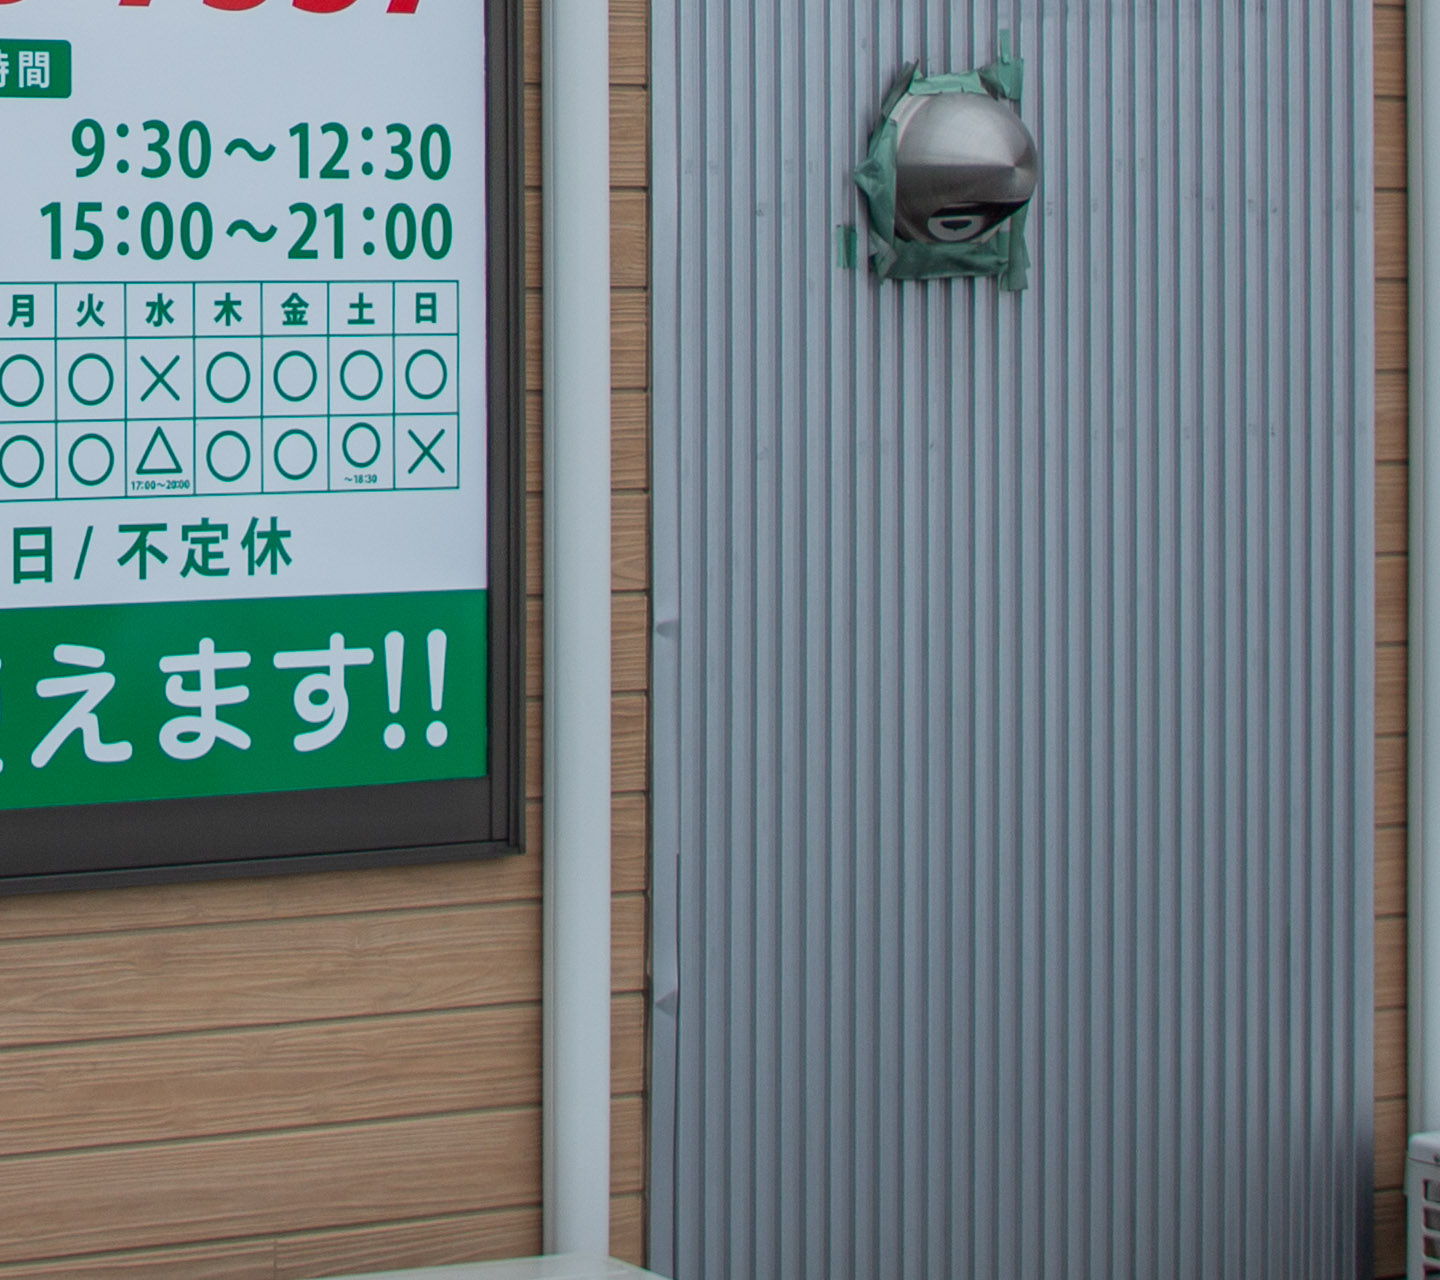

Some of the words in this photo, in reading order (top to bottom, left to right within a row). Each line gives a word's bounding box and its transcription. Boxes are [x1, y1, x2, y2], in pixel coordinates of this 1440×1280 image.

[8, 293, 34, 328] 月
[77, 293, 105, 327] 火
[146, 293, 174, 327] 水
[214, 293, 242, 326] 木
[281, 293, 309, 326] 金
[348, 293, 375, 325] 土
[416, 293, 437, 325] 日
